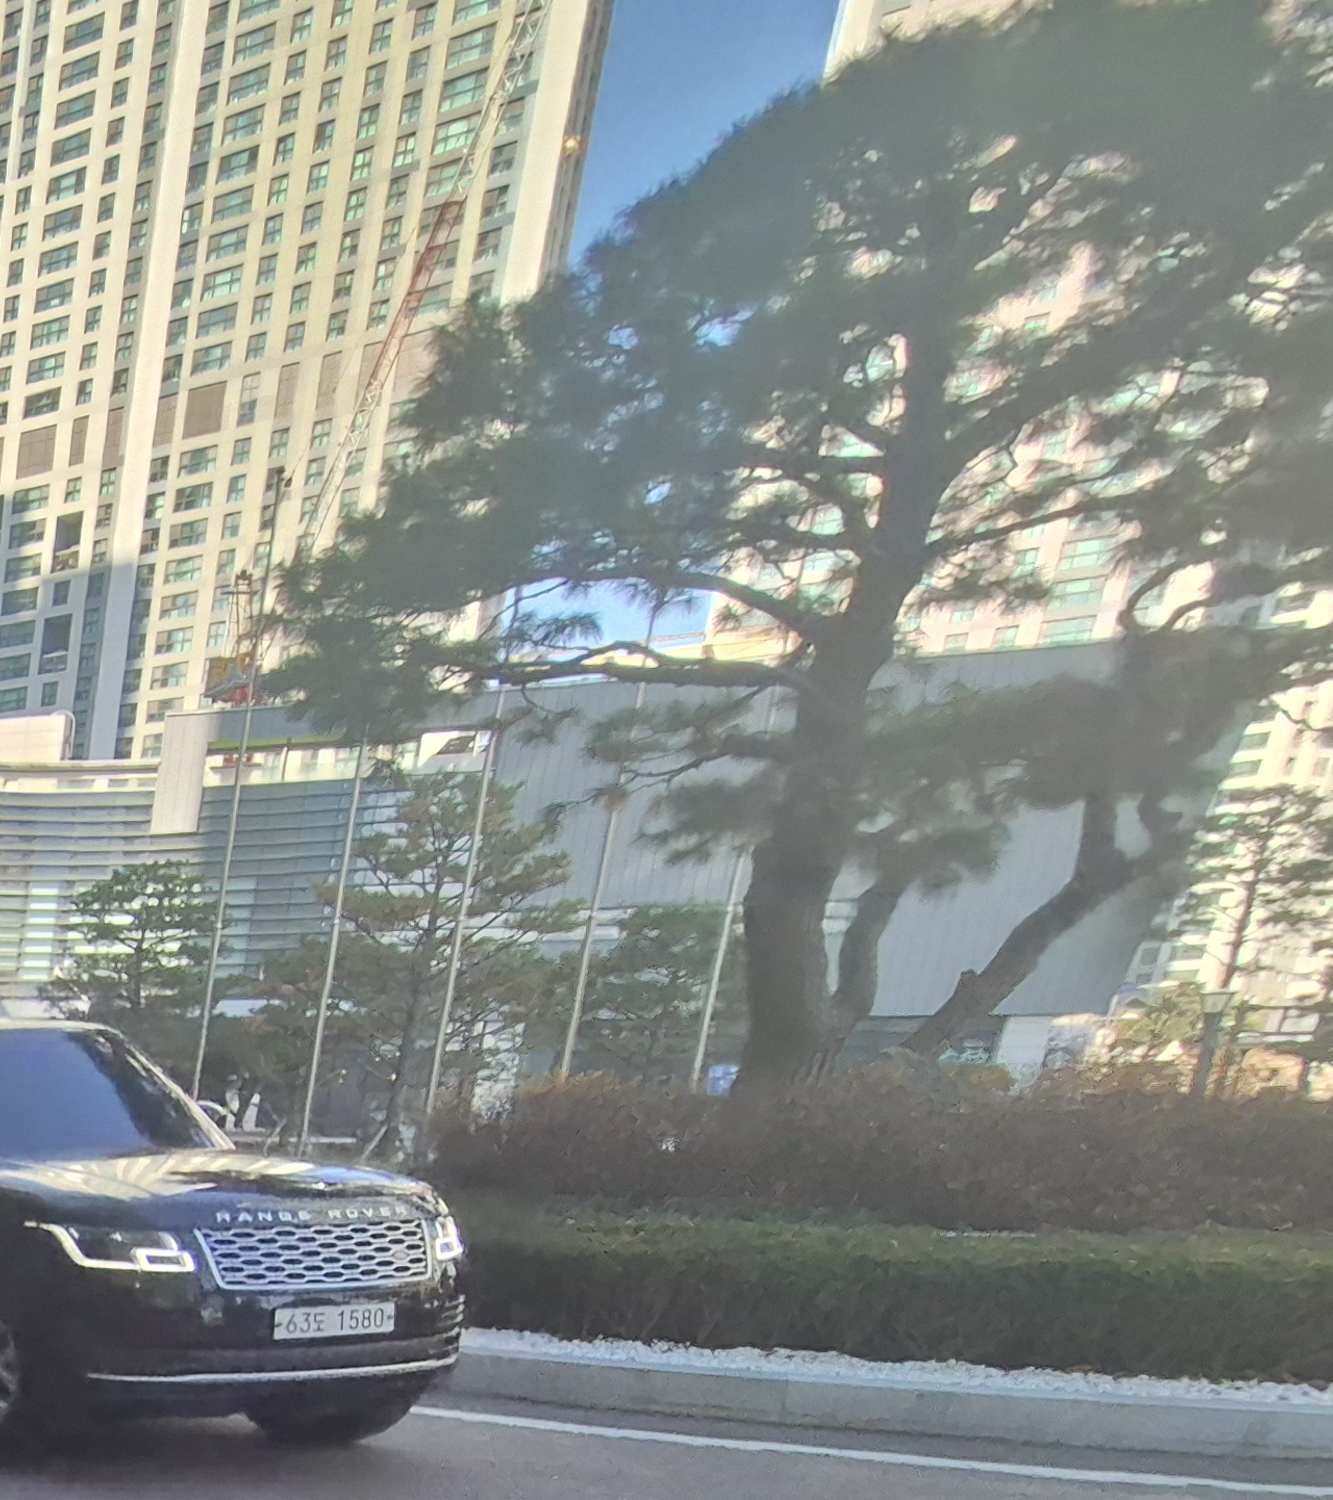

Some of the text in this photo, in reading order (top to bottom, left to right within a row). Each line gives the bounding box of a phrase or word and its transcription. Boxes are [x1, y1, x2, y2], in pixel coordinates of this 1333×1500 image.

[216, 1205, 409, 1223] RANGE ROVER
[338, 1308, 385, 1331] 1580
